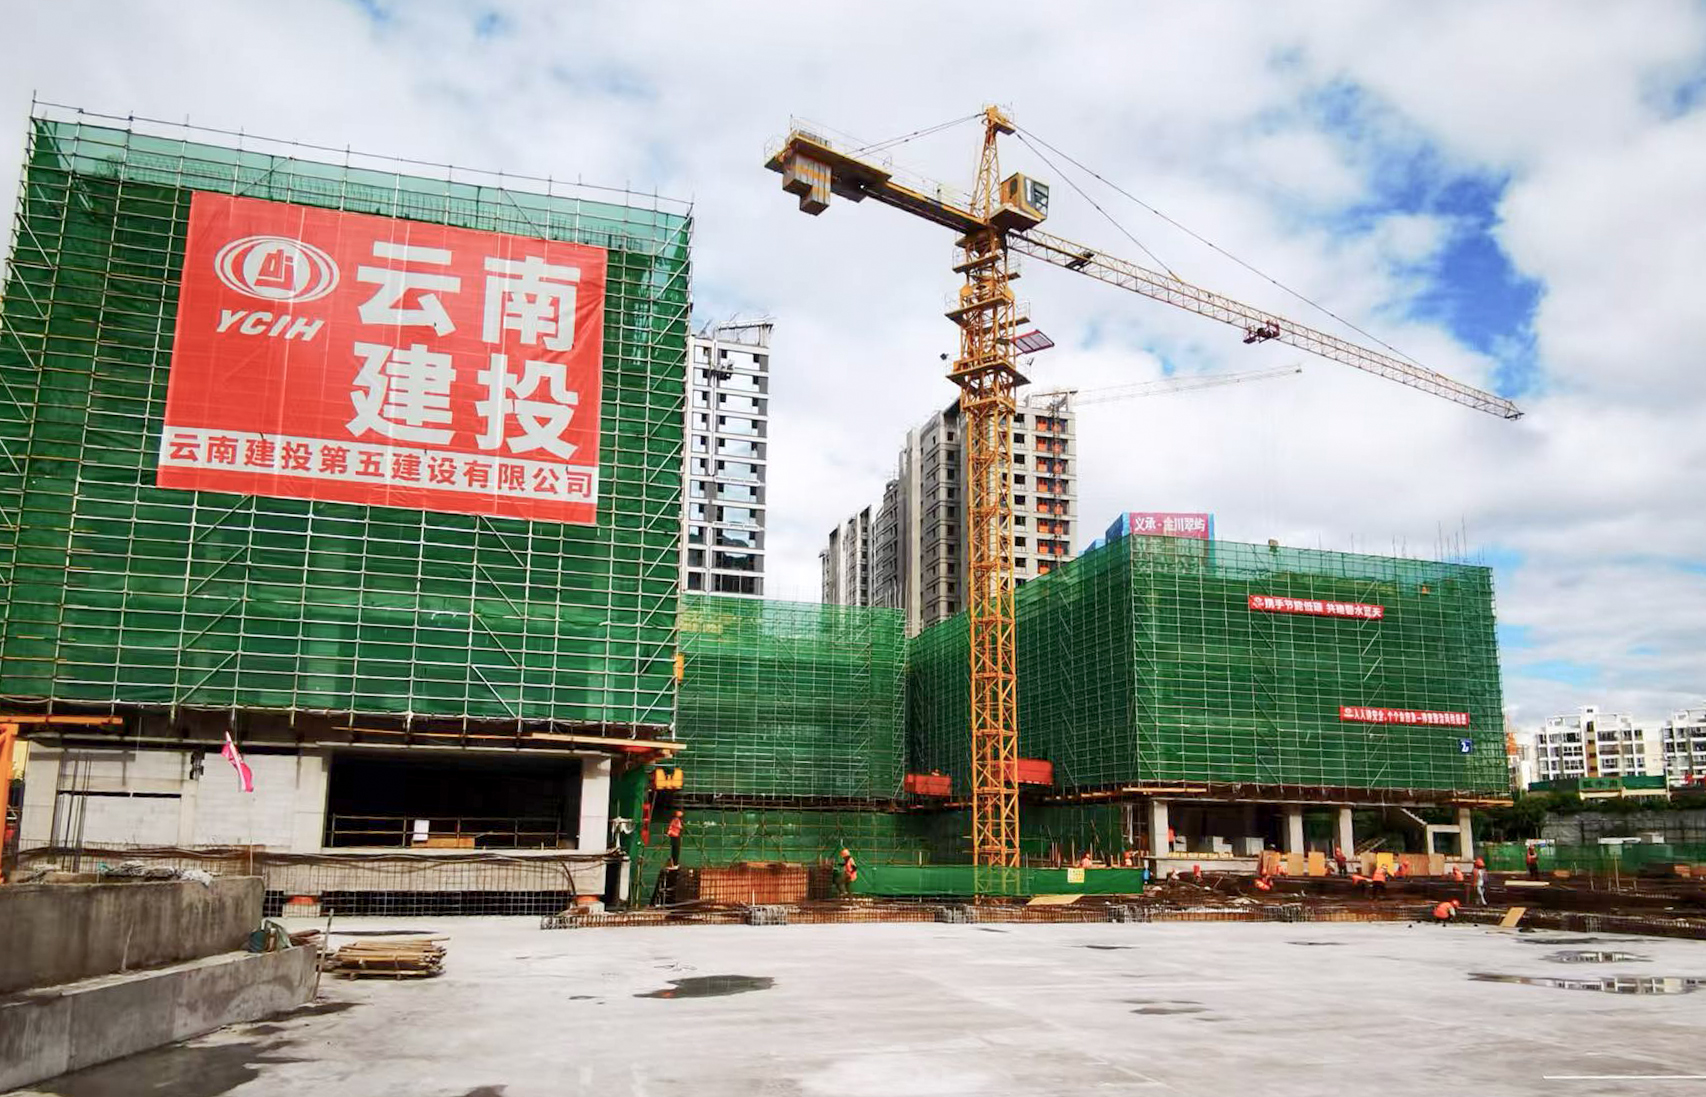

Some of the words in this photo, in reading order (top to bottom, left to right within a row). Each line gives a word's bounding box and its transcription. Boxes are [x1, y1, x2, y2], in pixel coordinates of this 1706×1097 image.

[215, 309, 325, 342] YCIH
[356, 241, 582, 353] 云南
[345, 343, 579, 461] 建投
[168, 432, 594, 499] 云南建投第五建设有限公司
